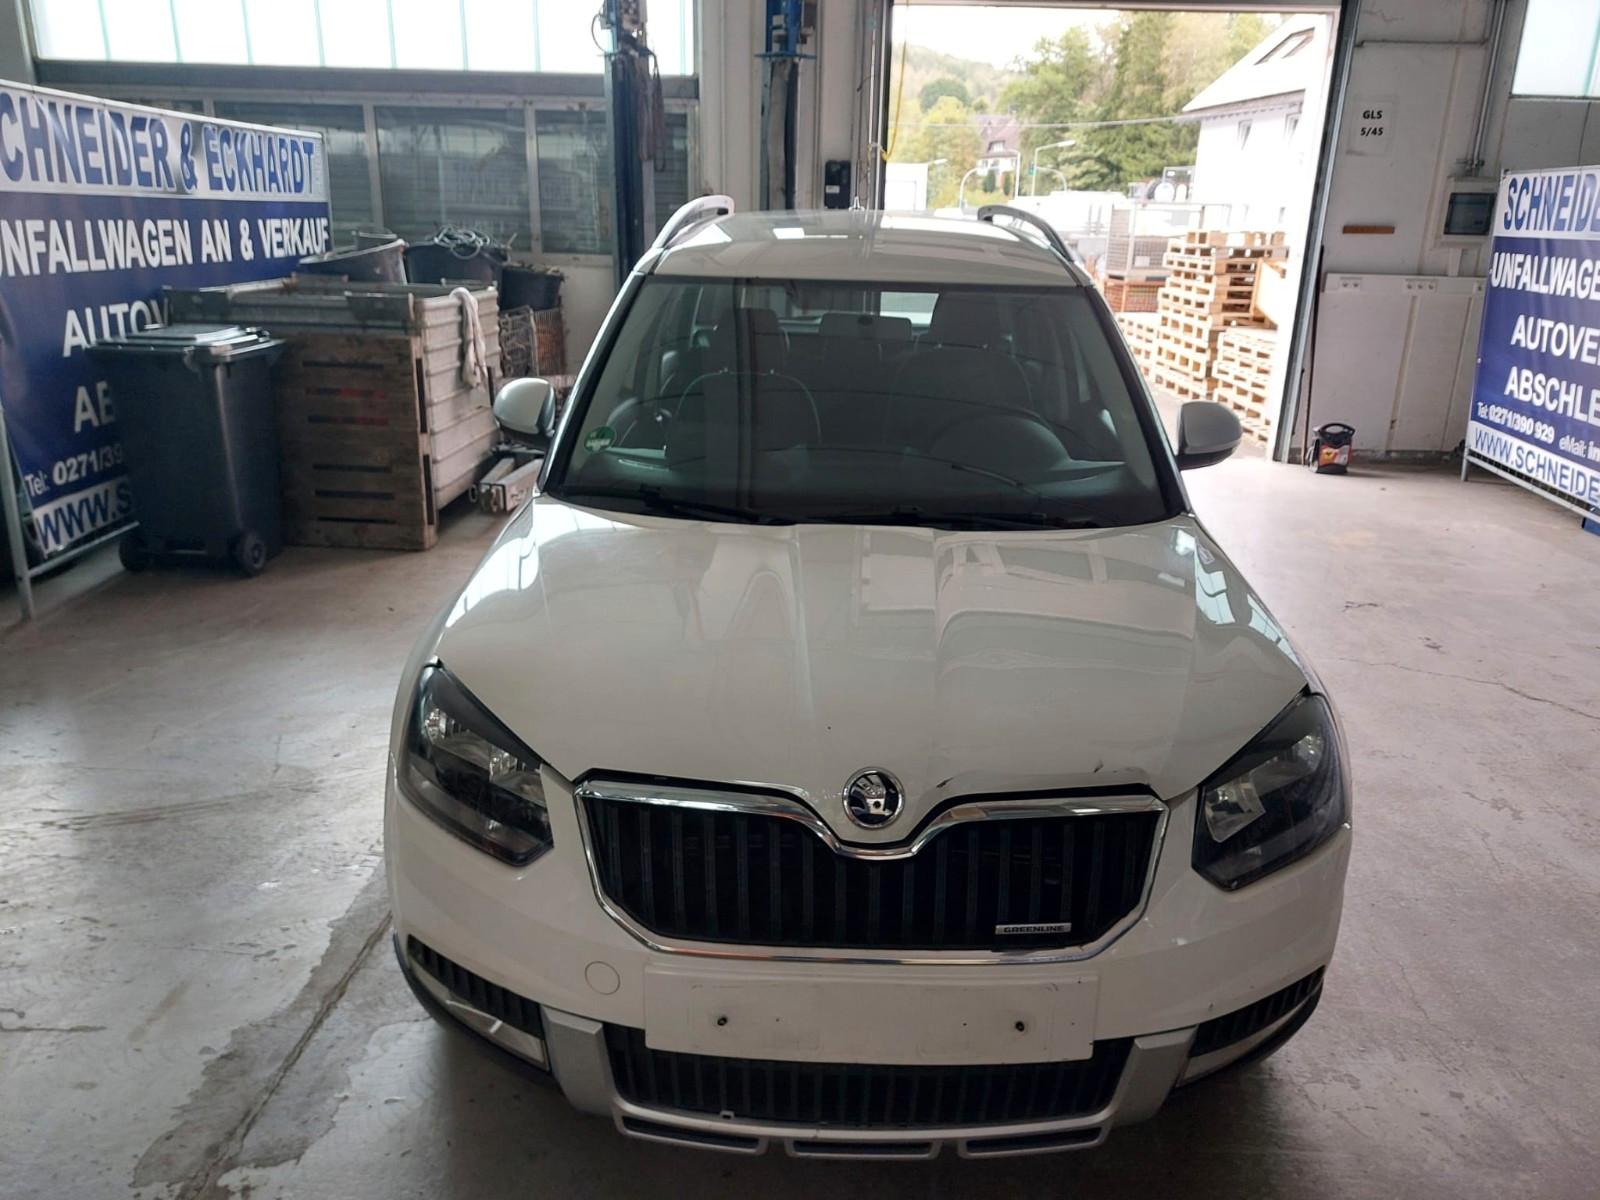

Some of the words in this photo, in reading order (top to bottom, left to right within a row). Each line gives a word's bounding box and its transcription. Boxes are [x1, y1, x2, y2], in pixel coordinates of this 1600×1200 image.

[1362, 110, 1383, 120] GLS
[1360, 127, 1384, 137] 5/45
[180, 121, 198, 193] &
[203, 125, 314, 194] ECKHARDT
[0, 219, 193, 277] NFALLWAGEN
[202, 219, 233, 263] AN
[239, 218, 254, 261] &
[258, 217, 329, 258] VERKAUF
[1511, 314, 1600, 366] AUTOVE
[1534, 421, 1555, 444] 929
[1003, 925, 1065, 934] GREENLINE
